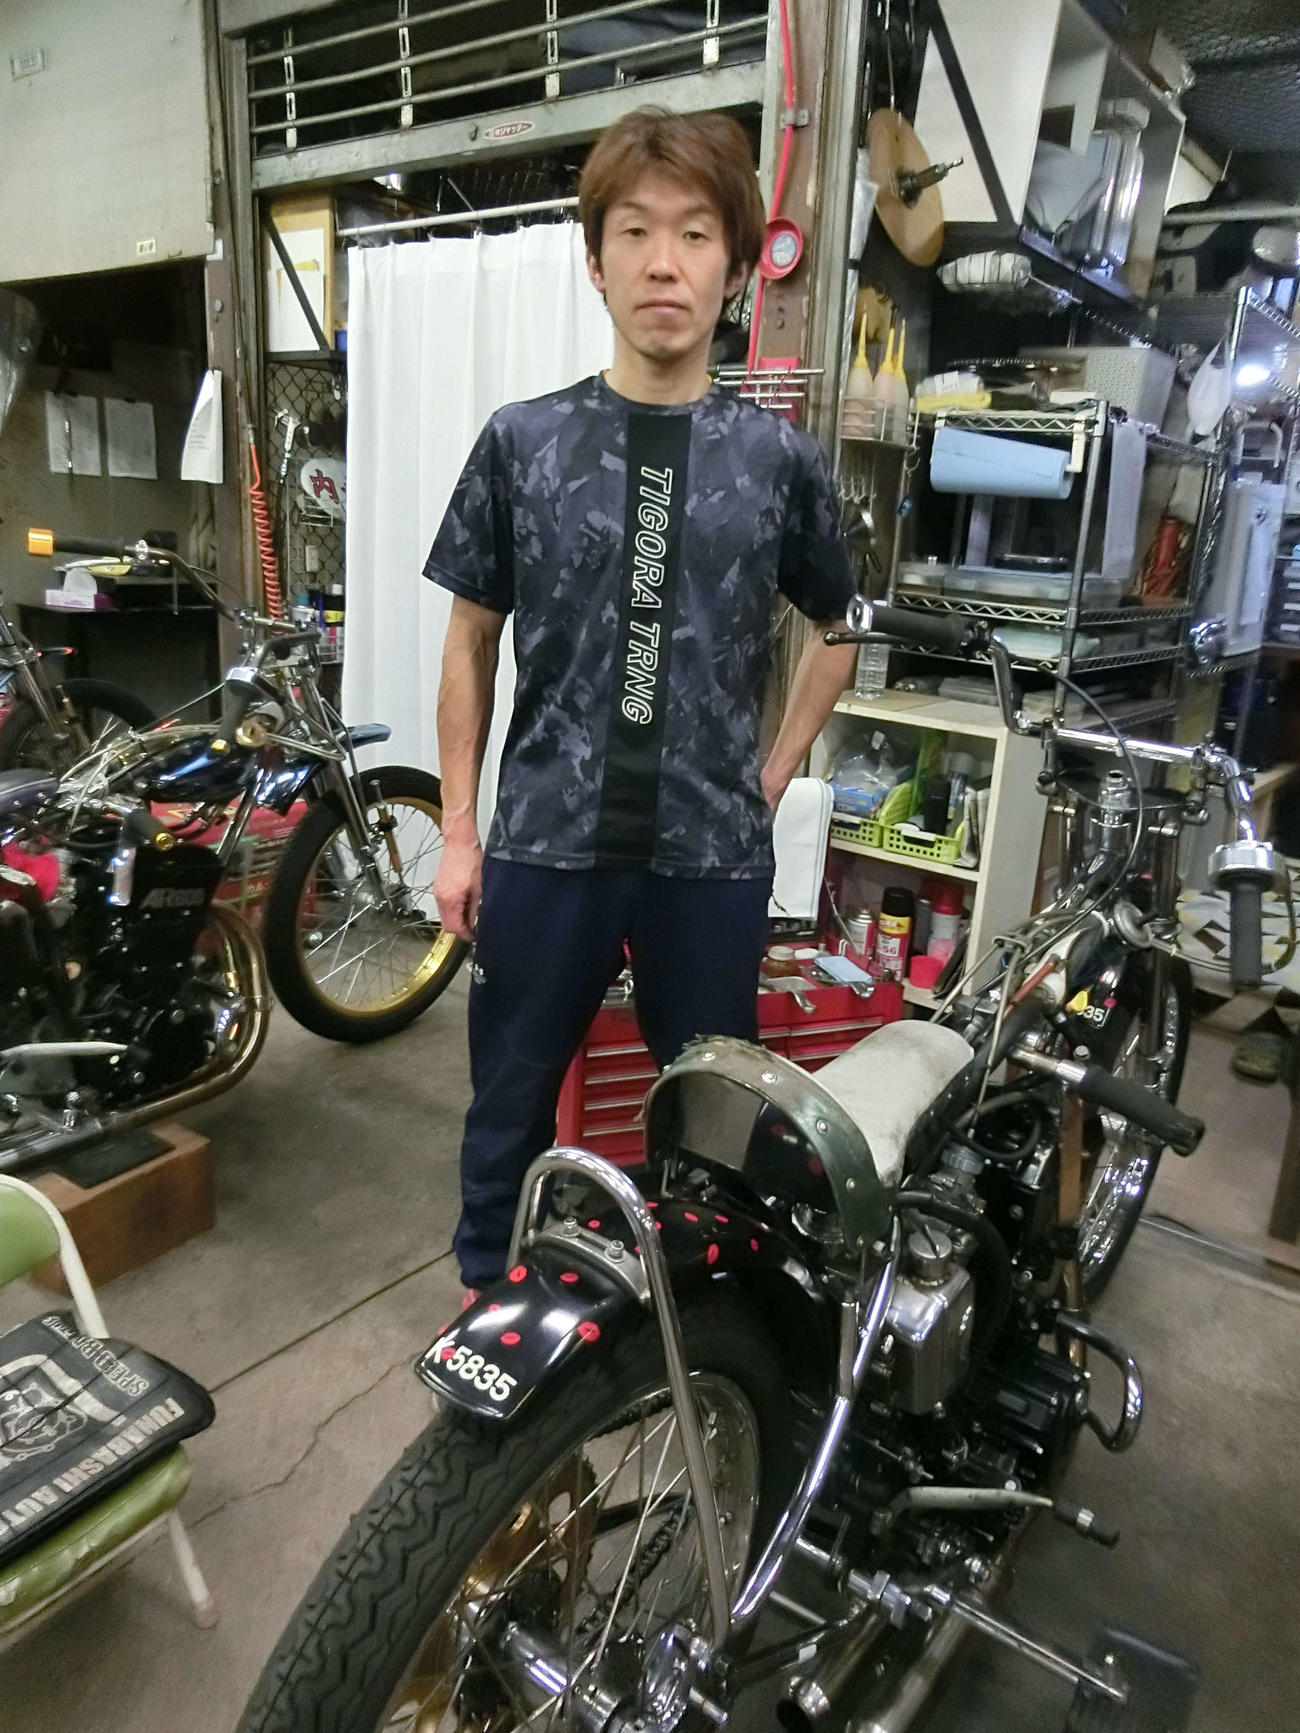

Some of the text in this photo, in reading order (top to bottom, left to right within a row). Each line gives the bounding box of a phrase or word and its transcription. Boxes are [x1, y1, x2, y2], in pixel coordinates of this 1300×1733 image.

[621, 466, 673, 725] TIGORA TRNG
[446, 1345, 518, 1401] 5835
[53, 1397, 185, 1493] FUNABASHI
